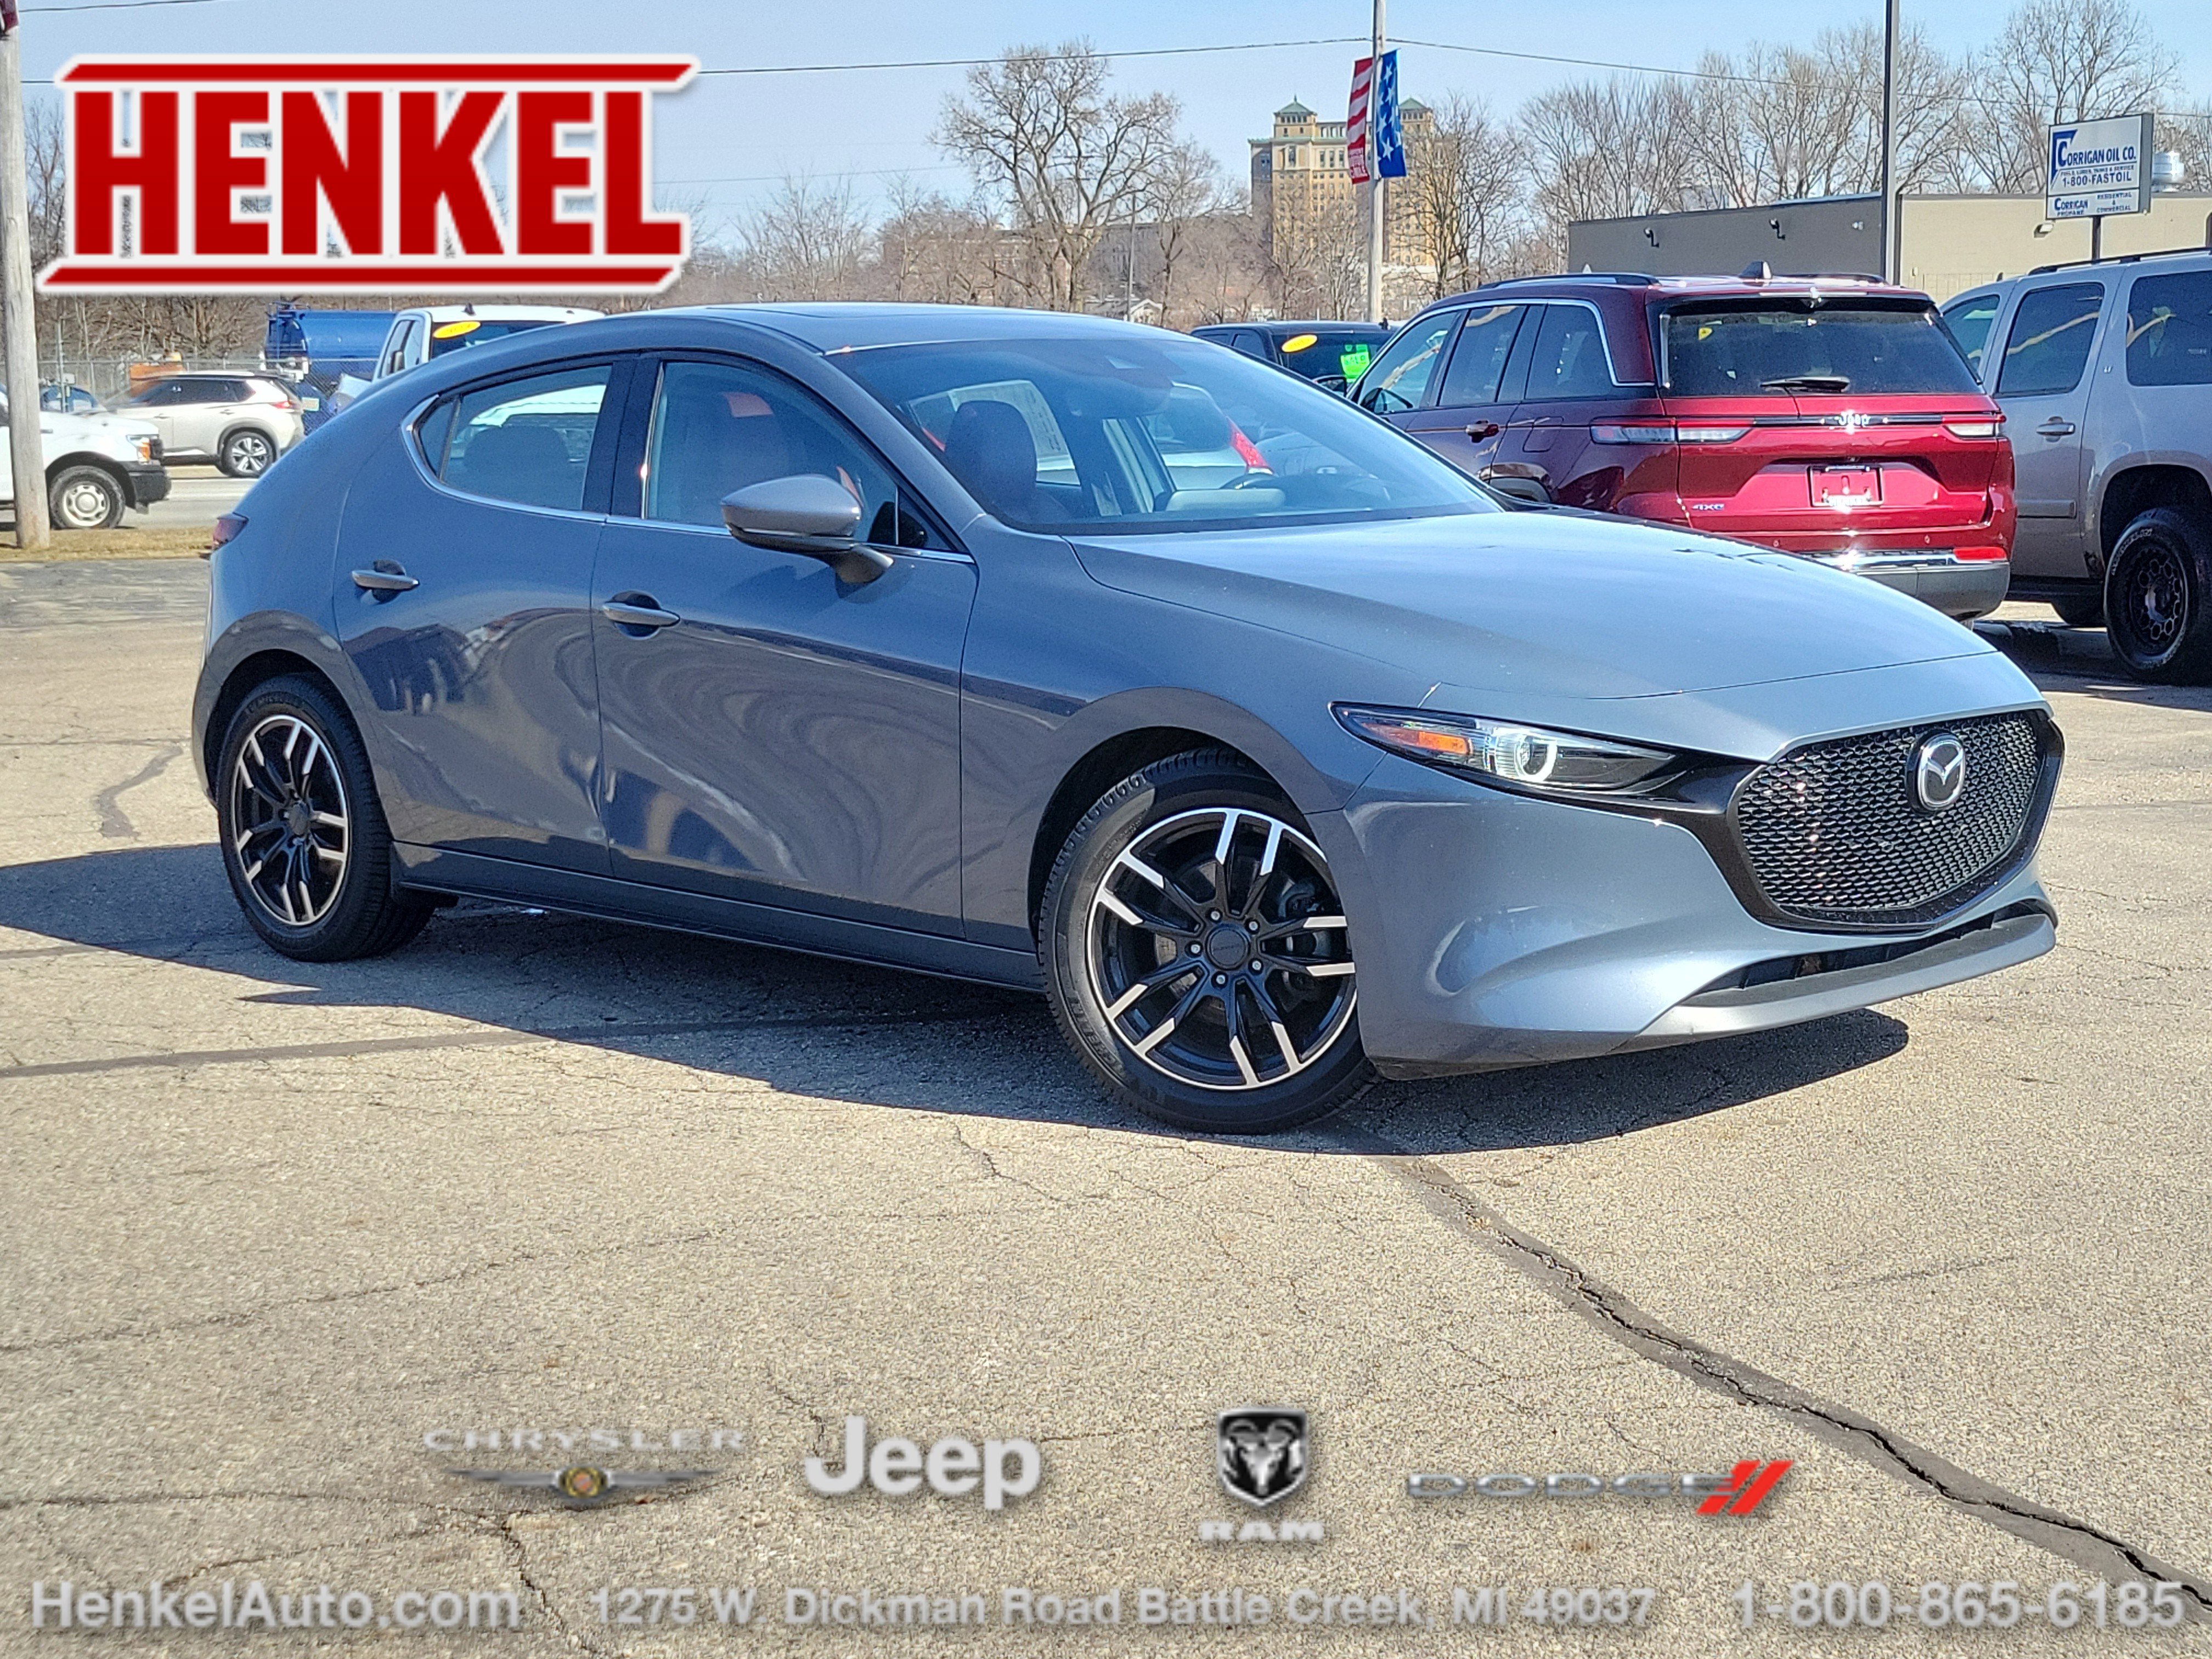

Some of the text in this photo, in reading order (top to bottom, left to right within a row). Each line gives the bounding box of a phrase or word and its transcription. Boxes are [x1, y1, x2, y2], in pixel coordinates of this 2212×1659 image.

[2057, 141, 2136, 167] CORRIGAN OIL CO.
[2062, 171, 2132, 187] 1-800-FASTOIL
[2054, 198, 2088, 211] CORRIGAN
